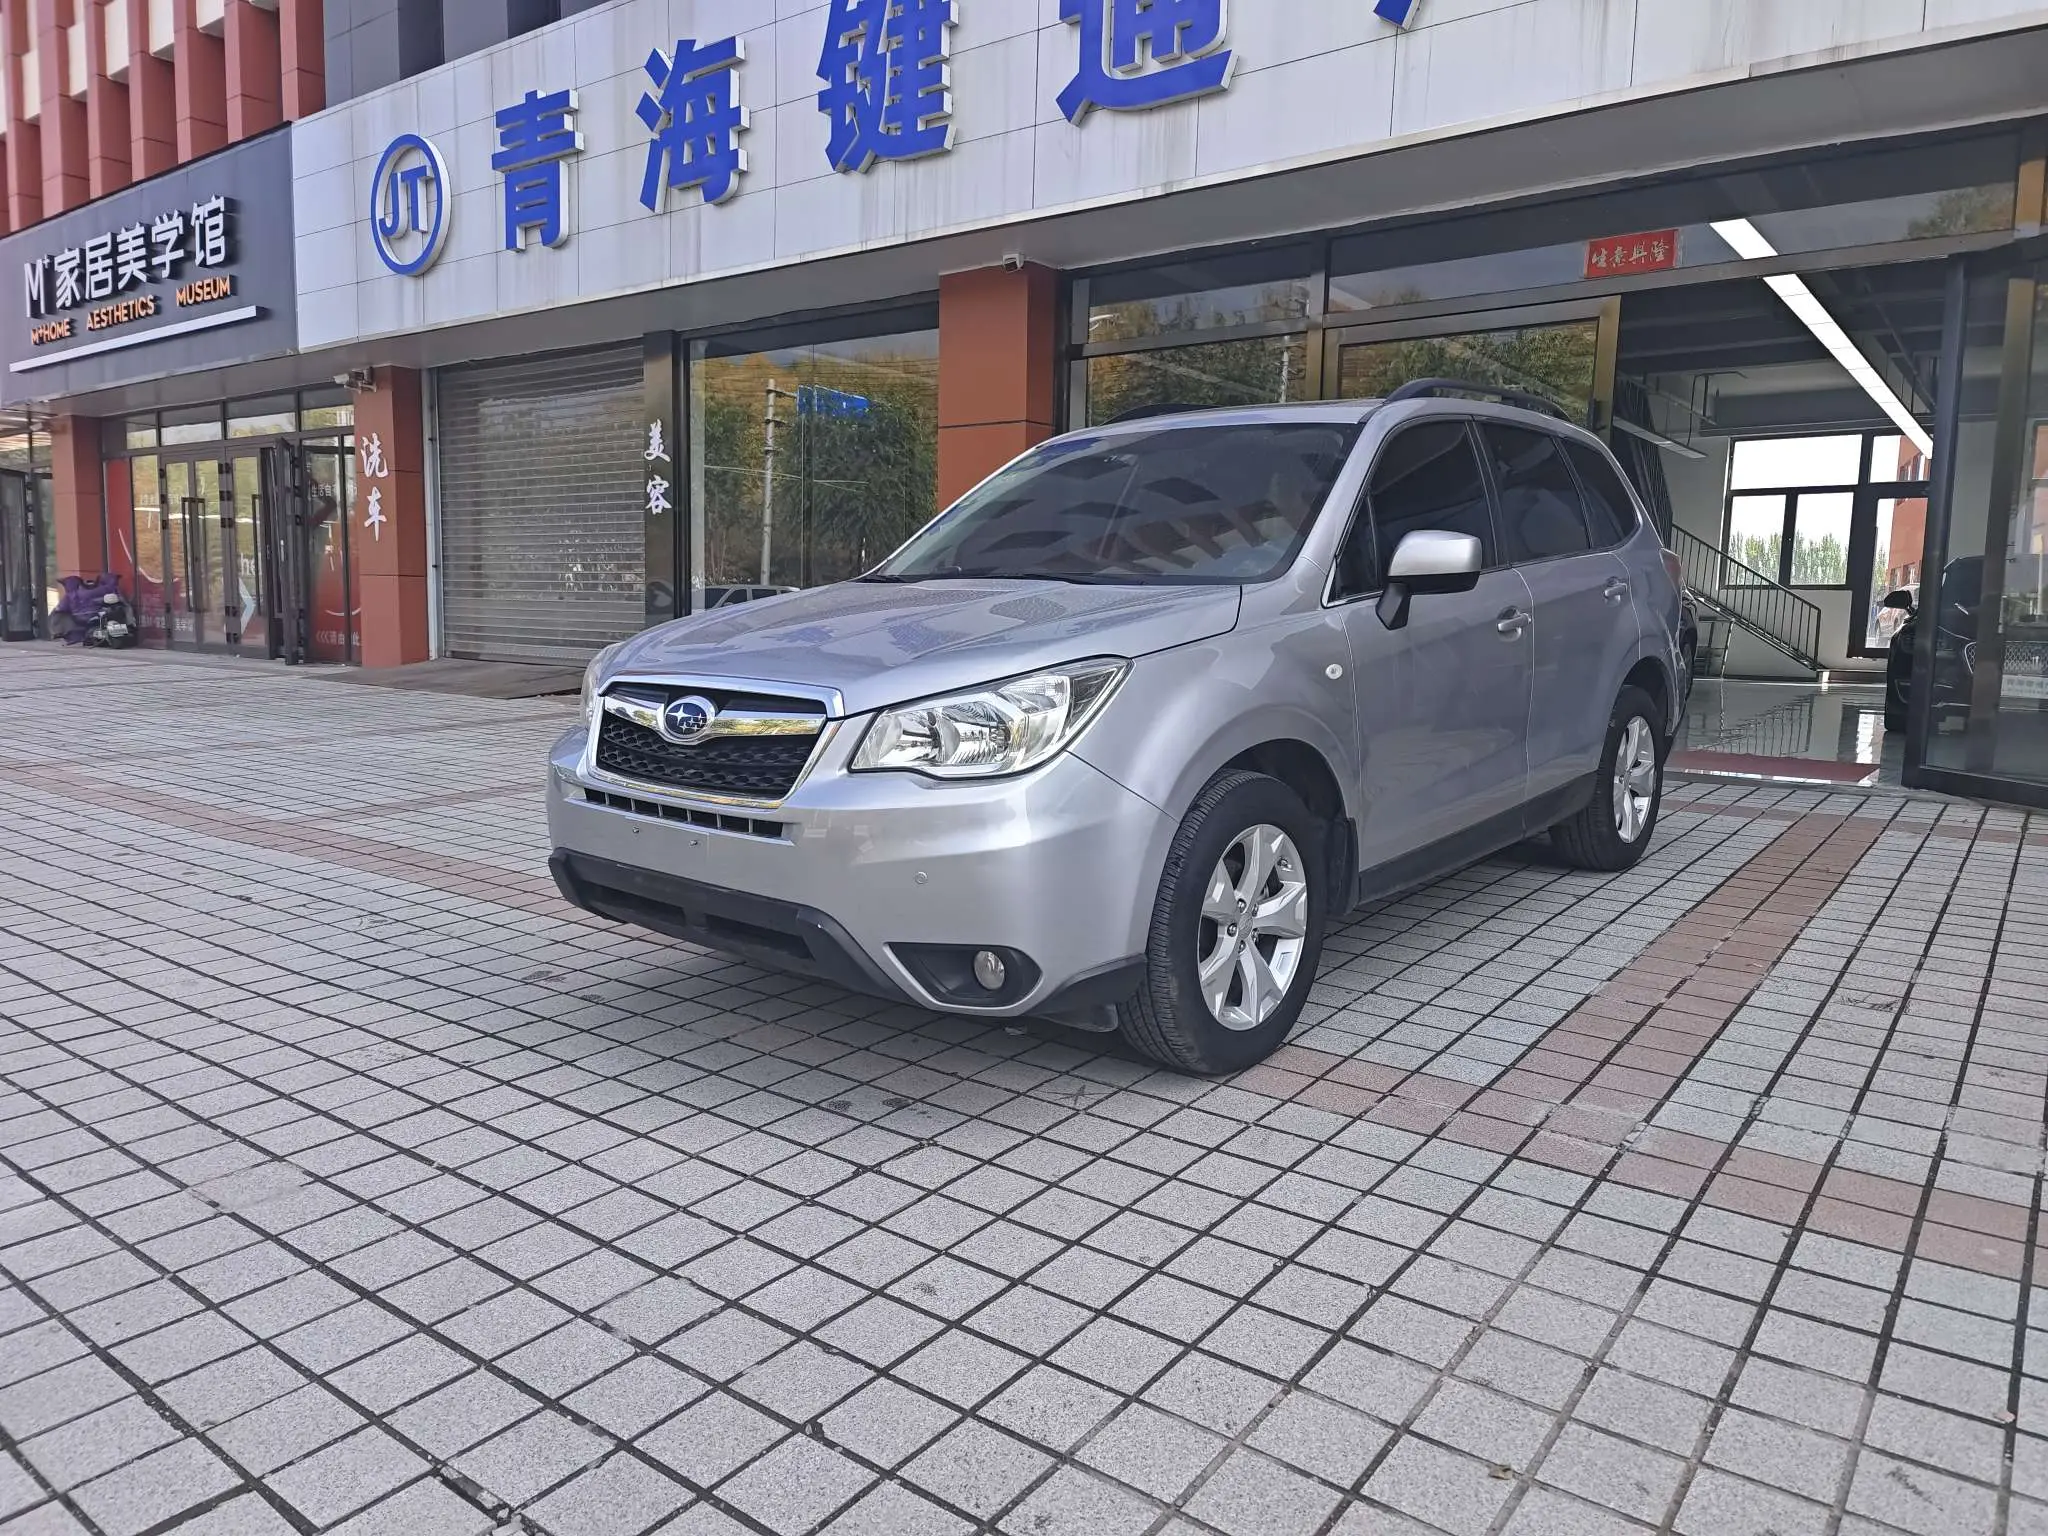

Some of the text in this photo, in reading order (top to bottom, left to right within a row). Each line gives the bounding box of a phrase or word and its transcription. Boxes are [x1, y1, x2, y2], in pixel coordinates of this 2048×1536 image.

[492, 0, 1408, 252] 青海键通
[378, 166, 430, 238] JT
[86, 294, 156, 331] AESTHETICS
[175, 275, 231, 307] MUSEUM
[361, 432, 388, 541] 洗车
[644, 419, 673, 515] 美容
